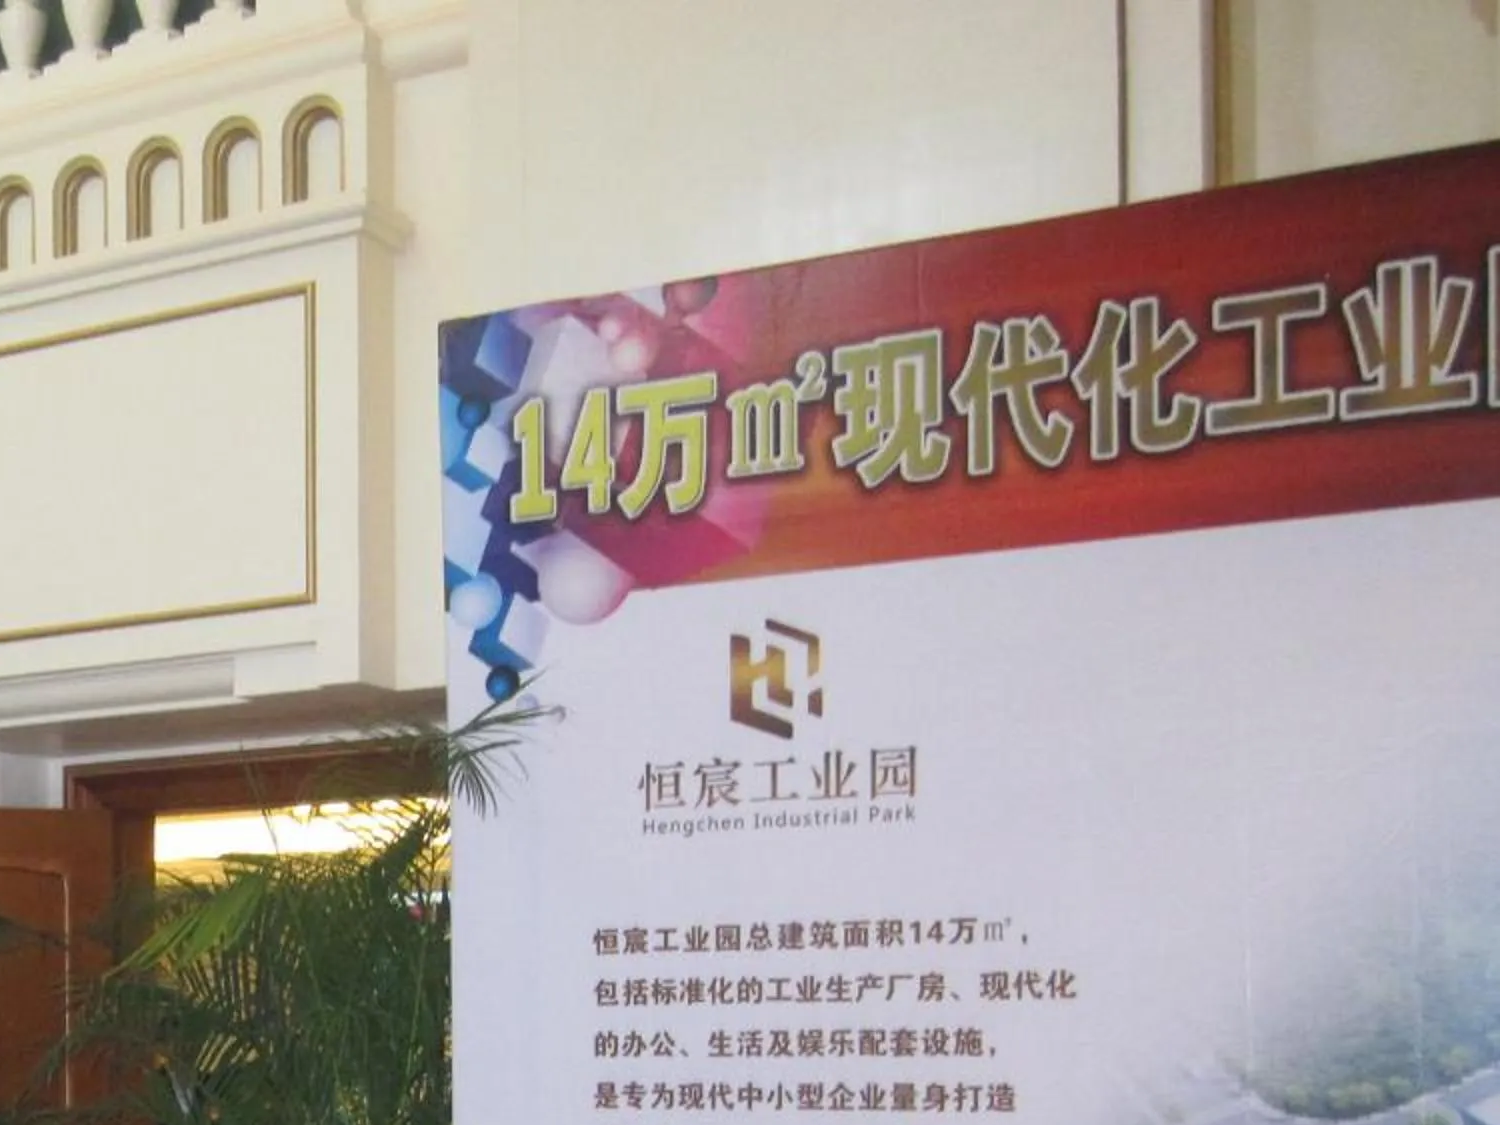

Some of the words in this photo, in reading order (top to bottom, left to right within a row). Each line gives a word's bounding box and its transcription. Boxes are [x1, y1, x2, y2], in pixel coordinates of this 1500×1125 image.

[509, 245, 1500, 525] 14万㎡现代化工业
[637, 744, 918, 813] 恒宸工业园
[642, 812, 745, 838] Hengchen
[753, 806, 859, 829] Industrial
[868, 802, 917, 822] Park
[594, 969, 1078, 1008] 包括标准化的工业生产厂房、现代化
[594, 1027, 997, 1058] 的办公、生活及娱乐配套设施，
[594, 1081, 1017, 1114] 是专为现代中小型企业量身打造
